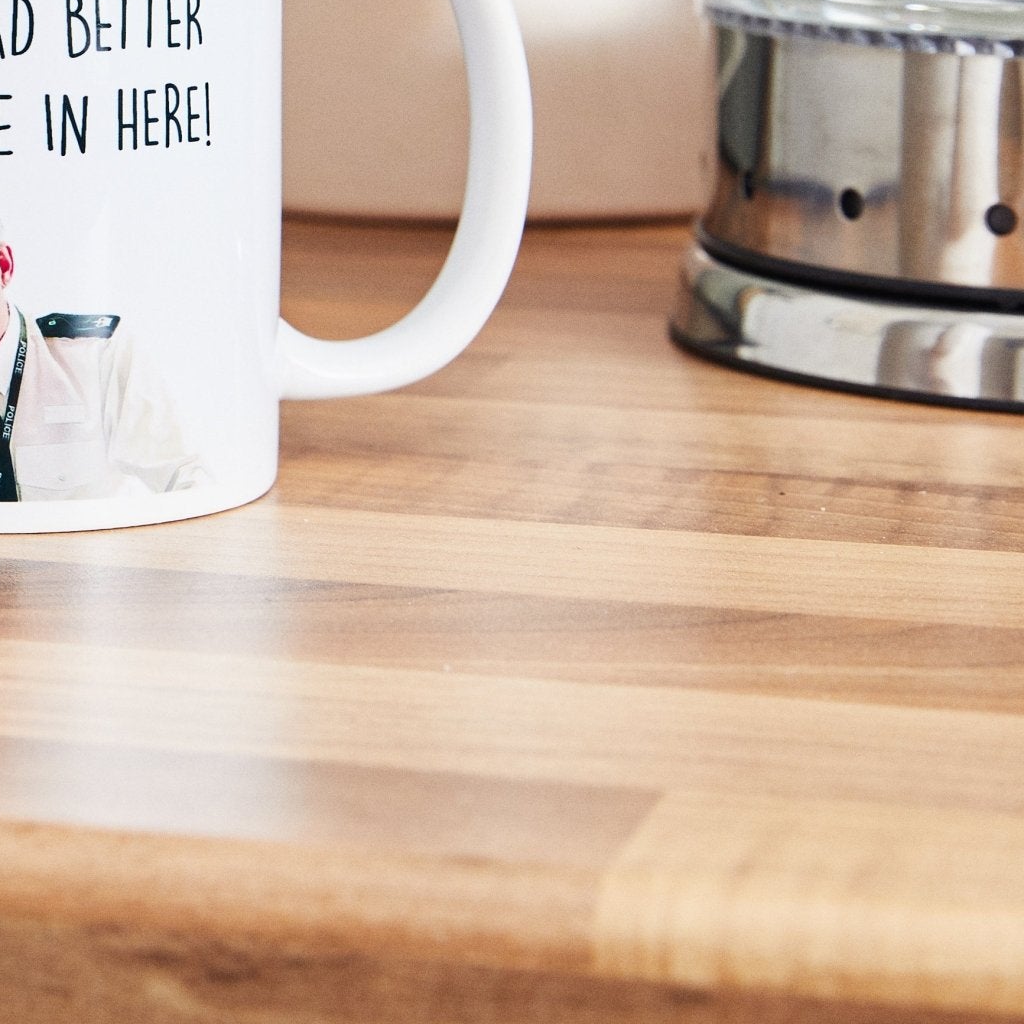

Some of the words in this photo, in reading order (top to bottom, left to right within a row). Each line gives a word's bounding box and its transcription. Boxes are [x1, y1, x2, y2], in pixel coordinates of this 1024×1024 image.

[44, 93, 89, 157] IN
[117, 81, 212, 151] HERE!
[15, 339, 27, 374] POLICE
[2, 405, 16, 440] POLICE
